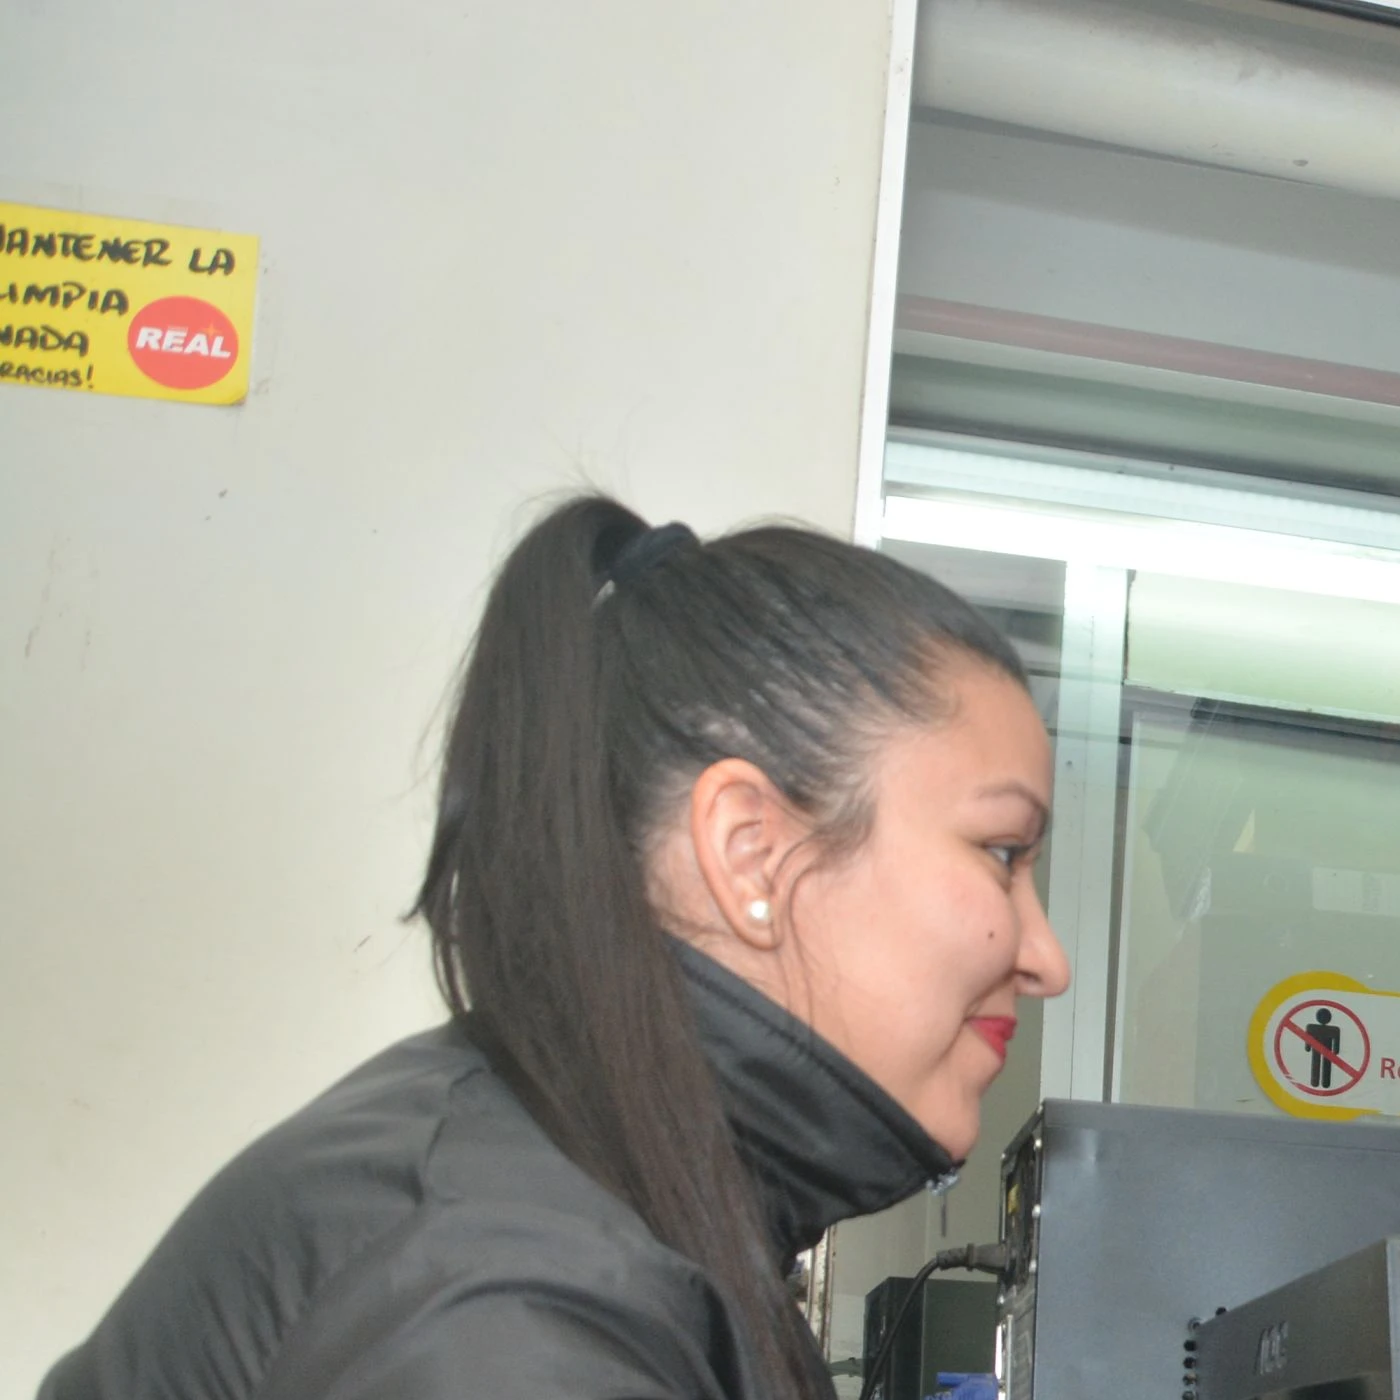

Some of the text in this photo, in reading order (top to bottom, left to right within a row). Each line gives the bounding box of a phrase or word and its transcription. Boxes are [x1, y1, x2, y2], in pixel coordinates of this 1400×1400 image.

[0, 224, 236, 276] ANTENER LA
[136, 326, 232, 359] REAL
